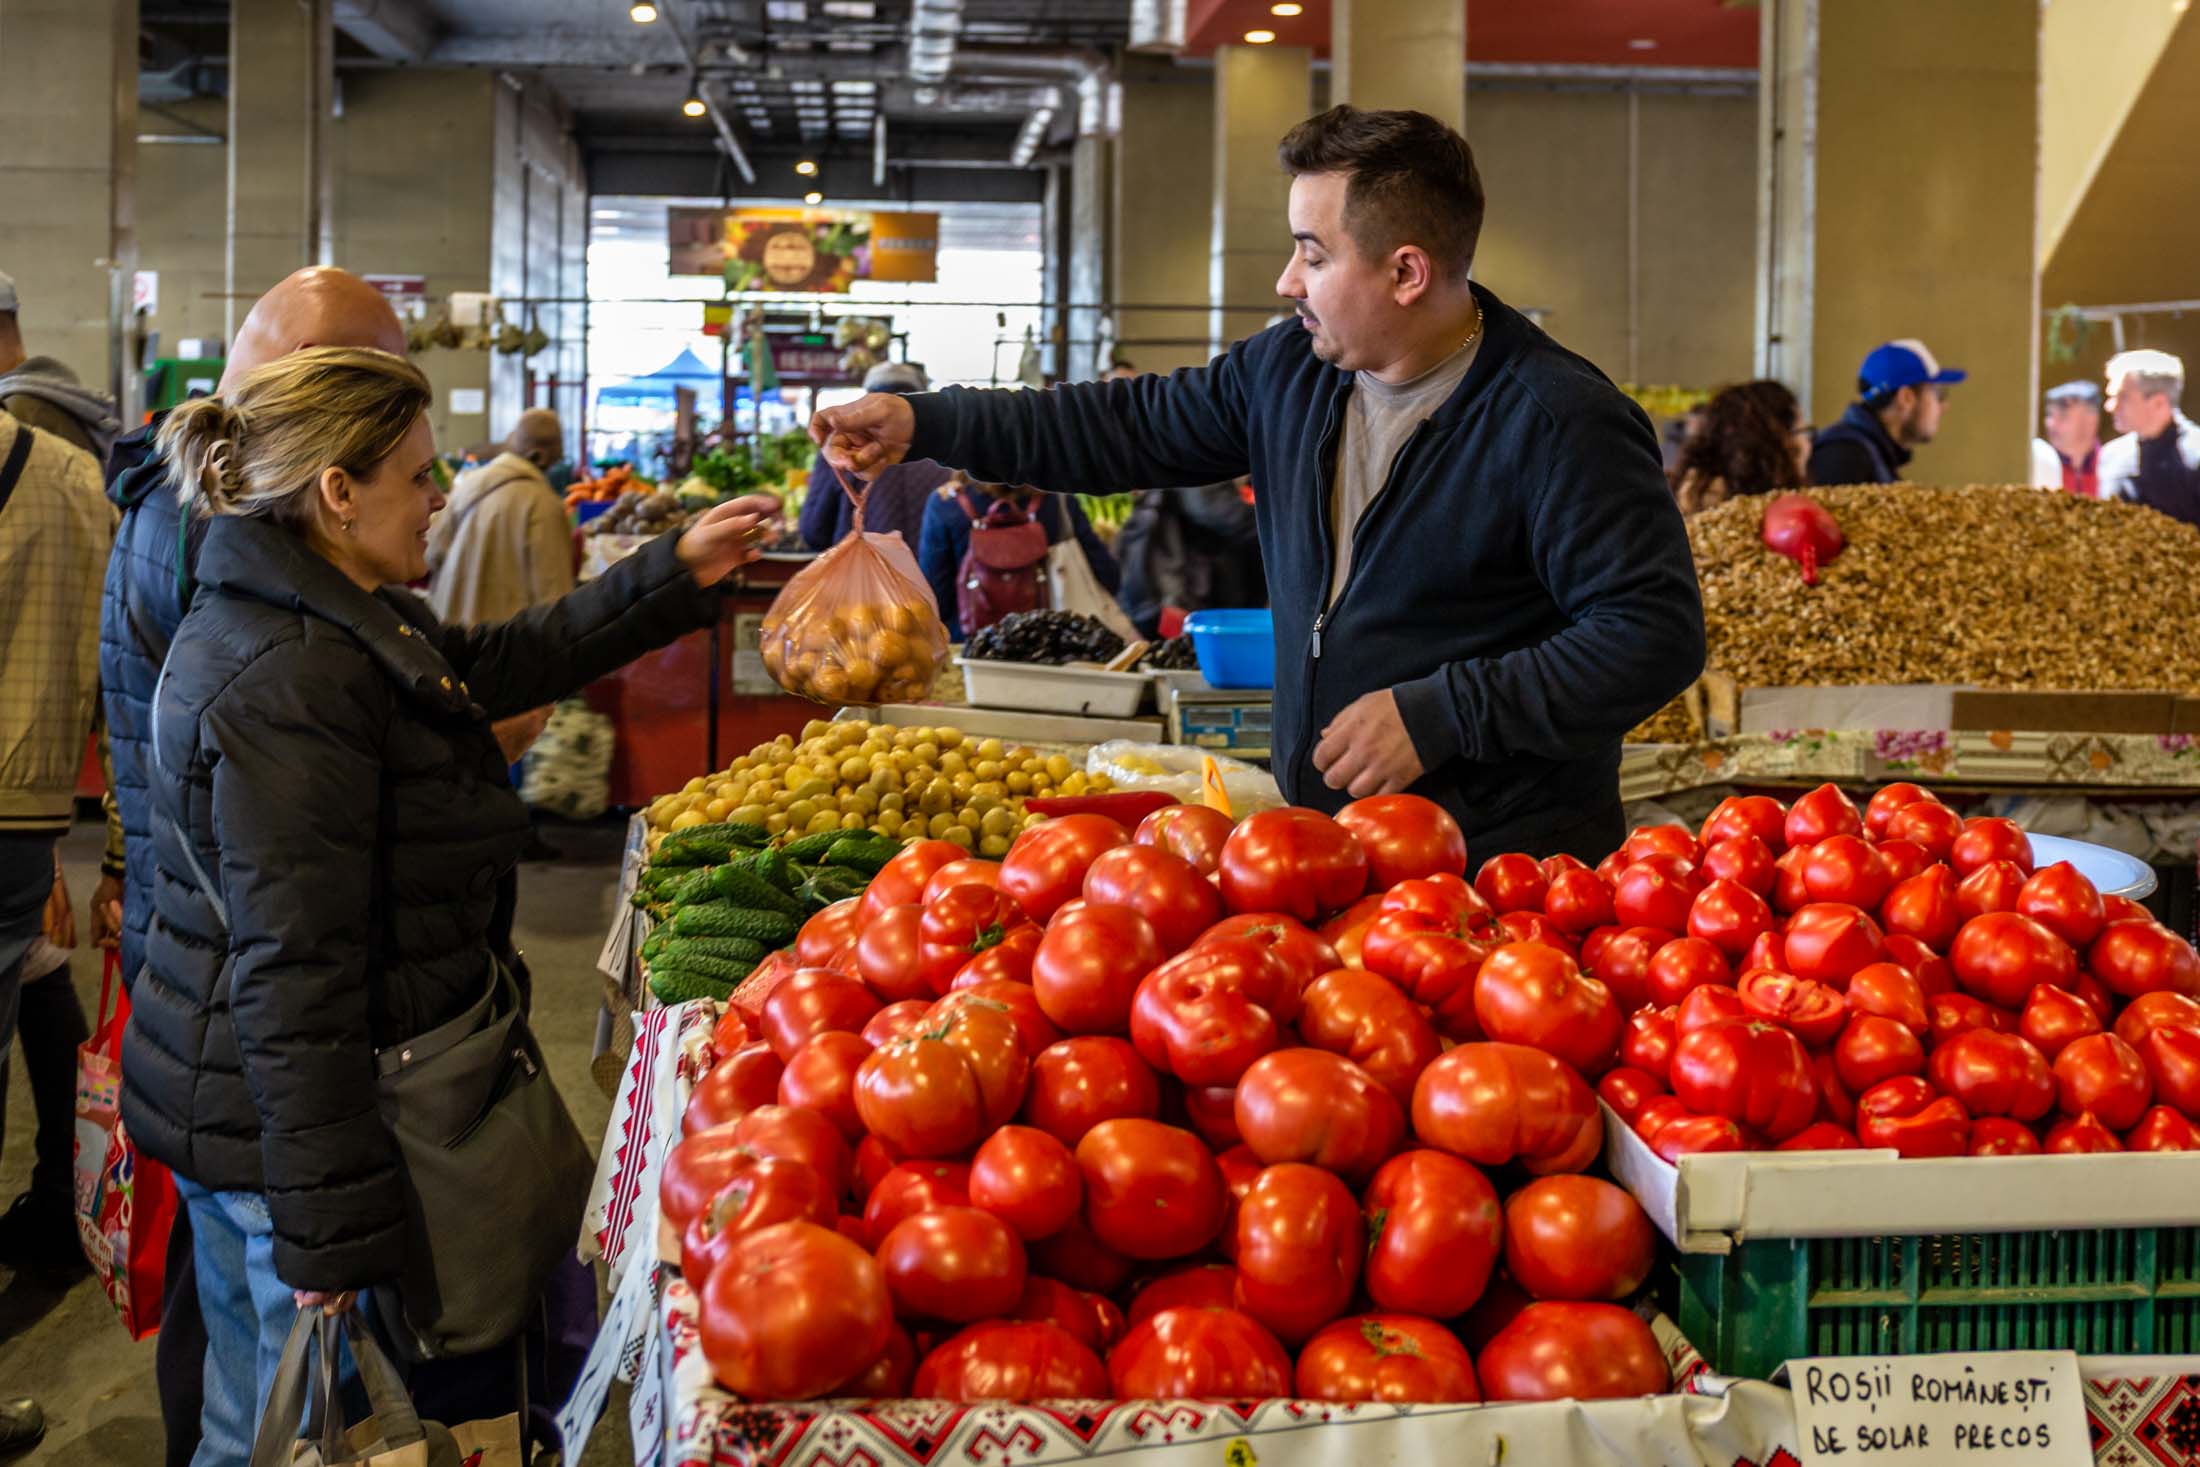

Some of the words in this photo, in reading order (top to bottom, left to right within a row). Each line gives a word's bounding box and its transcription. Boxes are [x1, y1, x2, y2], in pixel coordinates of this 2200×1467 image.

[1813, 1424, 1847, 1455] DE
[1857, 1424, 1930, 1452] SOLAR
[1955, 1423, 2051, 1449] PRECOS
